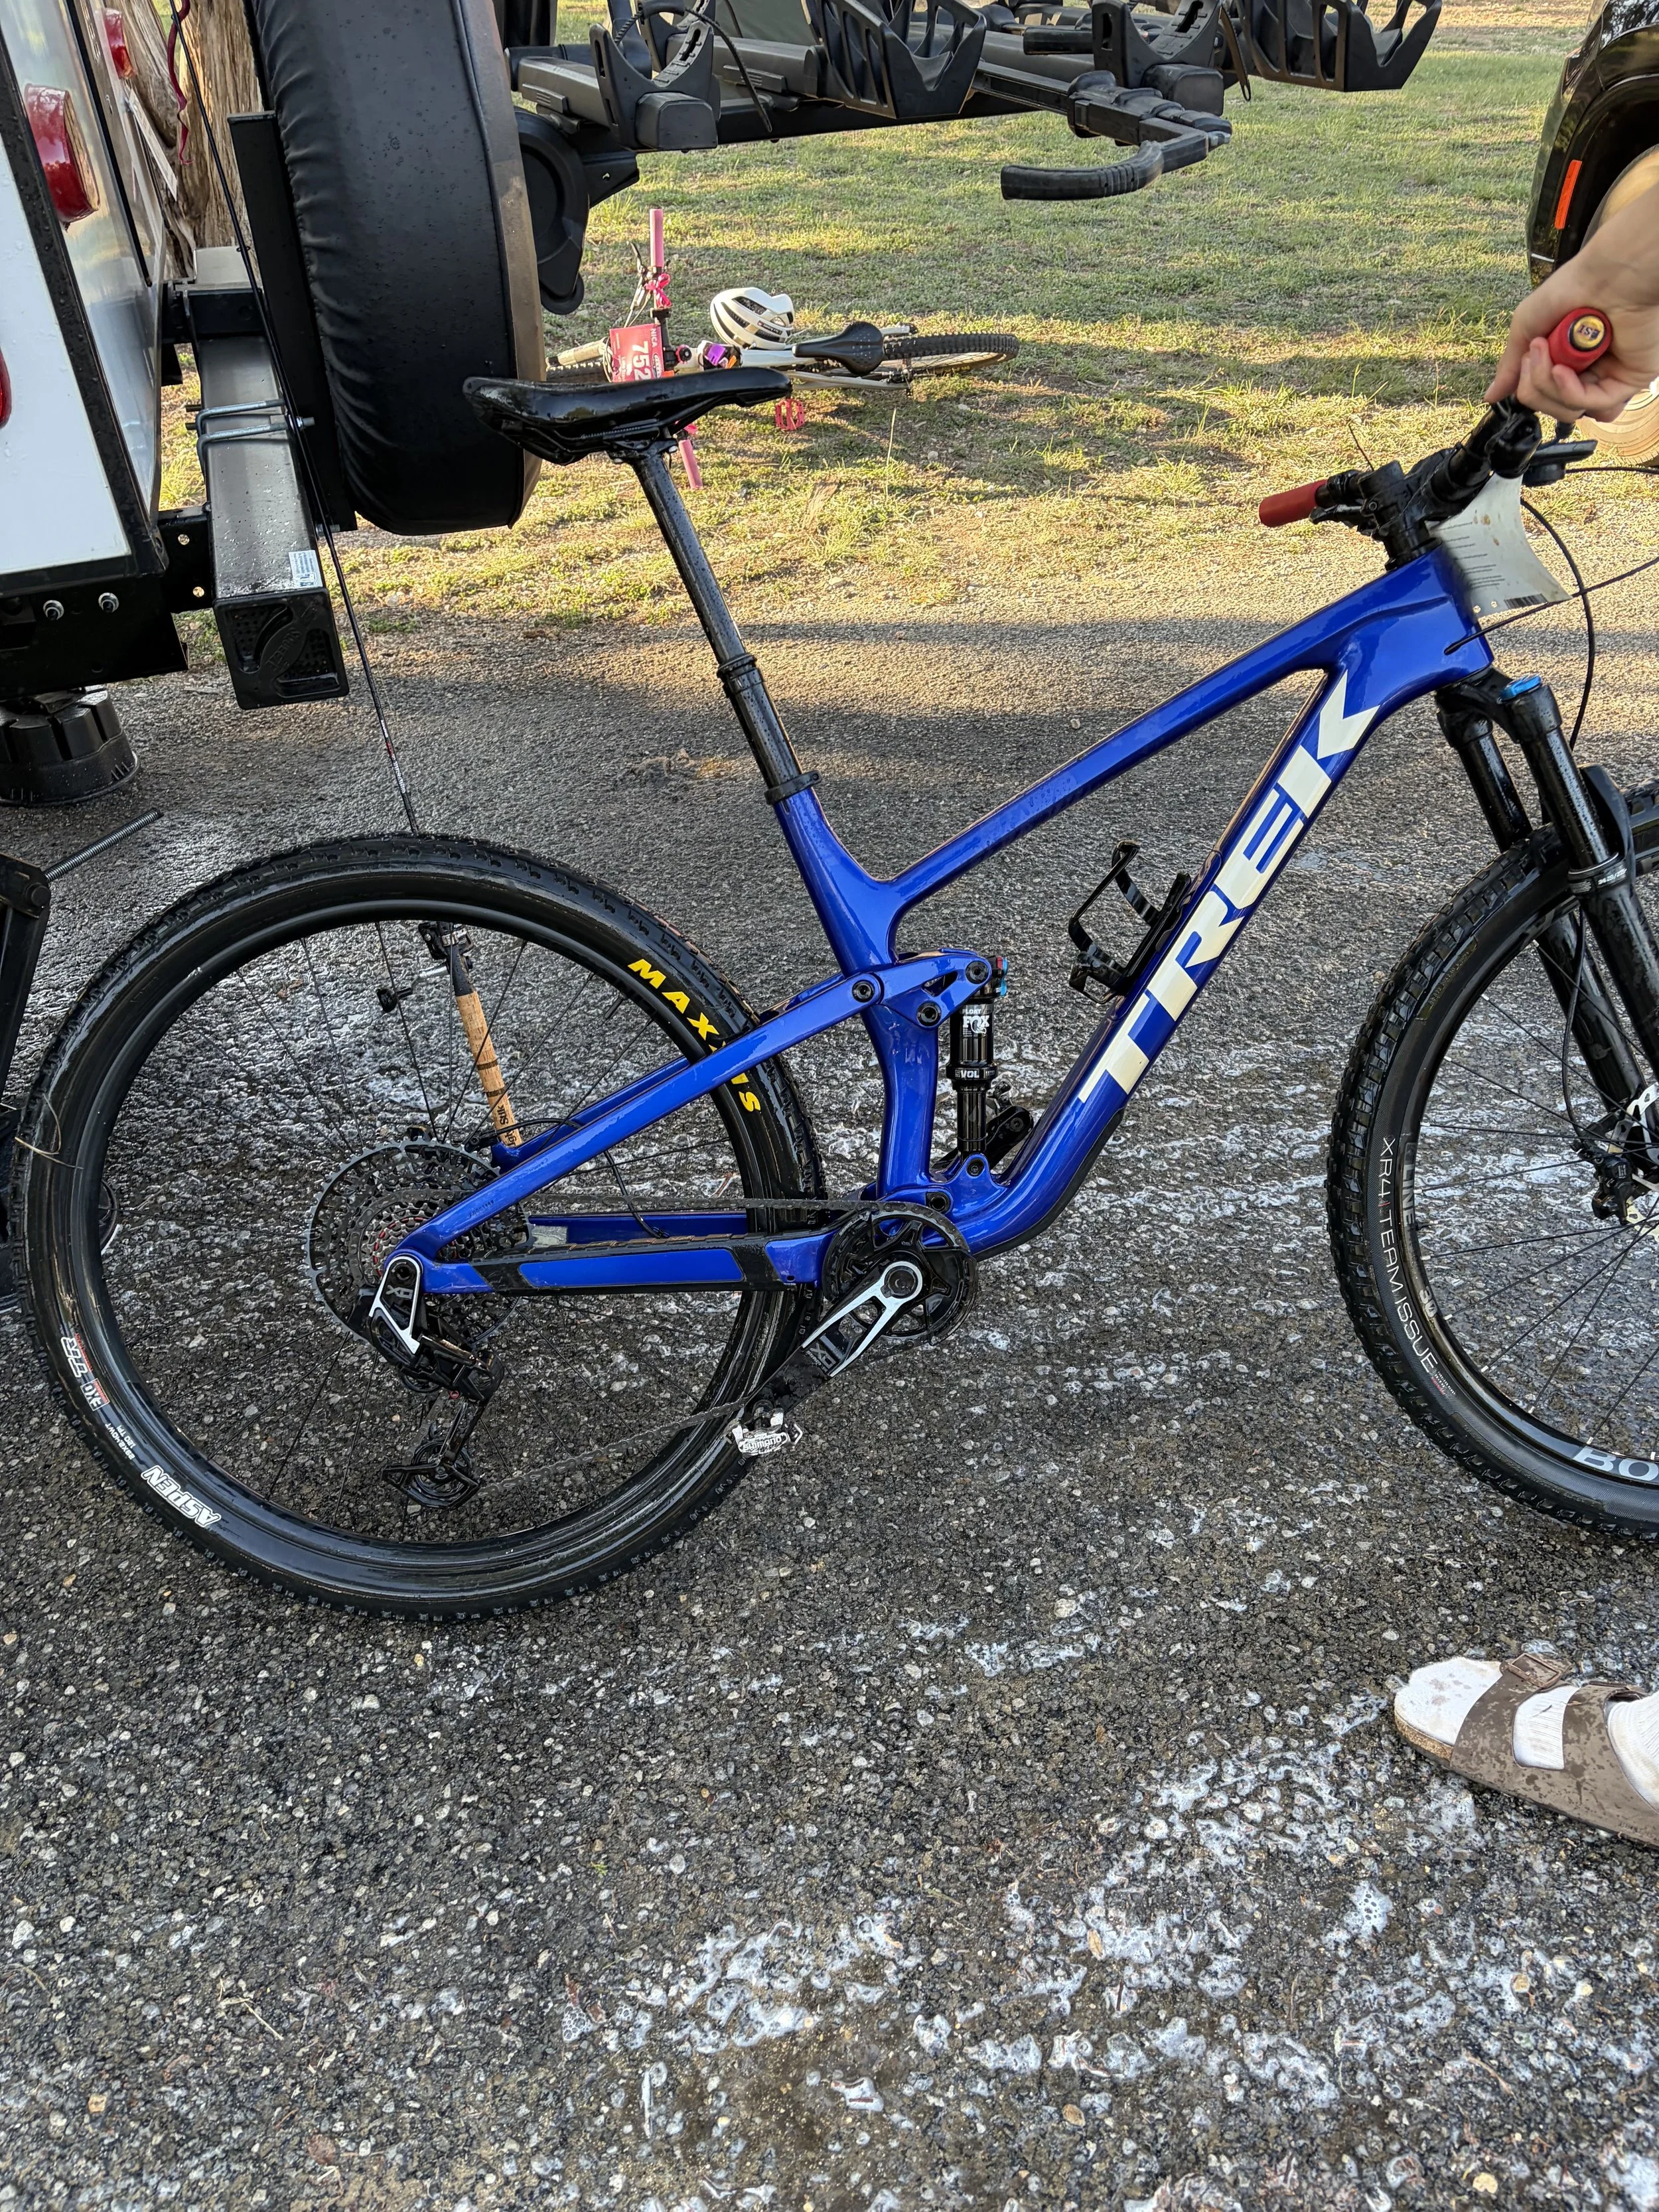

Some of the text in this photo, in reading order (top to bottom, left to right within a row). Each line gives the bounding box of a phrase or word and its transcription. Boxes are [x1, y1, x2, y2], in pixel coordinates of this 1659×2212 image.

[632, 340, 651, 380] 752
[1078, 670, 1380, 1103] TREK
[962, 1015, 989, 1035] FOX
[1378, 1137, 1438, 1373] XR4 TEAM ISSUE
[1402, 1164, 1438, 1318] LINE 30
[60, 1336, 88, 1378] TR
[84, 1384, 102, 1407] EXO
[105, 1423, 135, 1460] 29X2.40WT
[115, 1424, 137, 1449] 120 TPI
[141, 1465, 222, 1528] ASPEN
